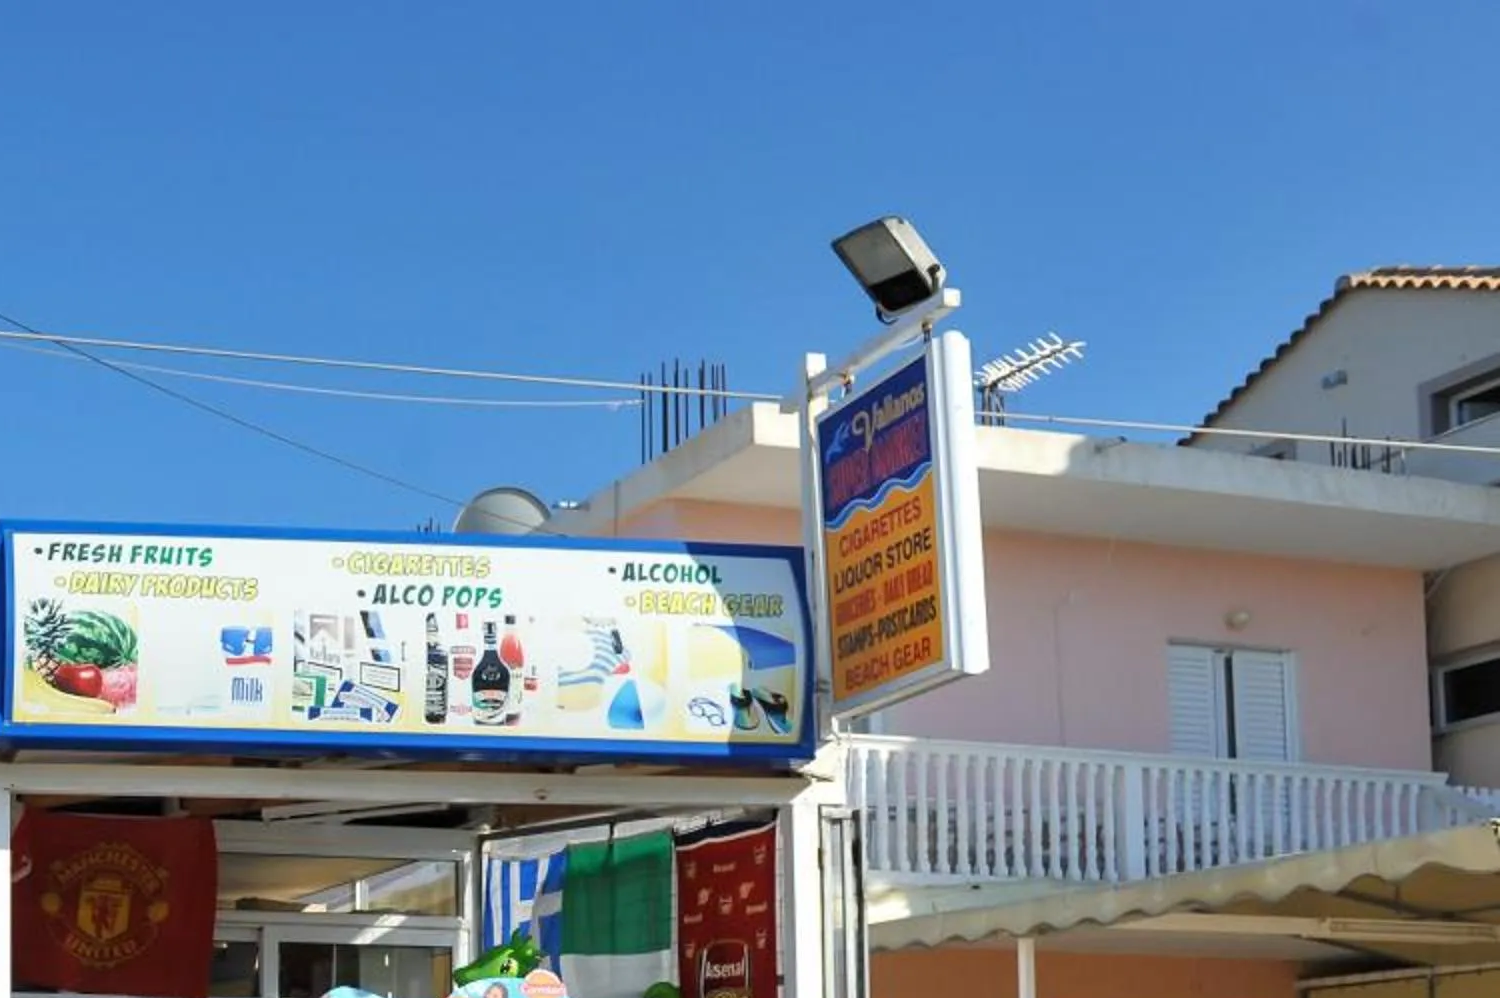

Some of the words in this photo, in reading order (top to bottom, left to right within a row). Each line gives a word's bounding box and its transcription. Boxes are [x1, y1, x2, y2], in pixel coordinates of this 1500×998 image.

[838, 496, 921, 557] CIGARETTES
[47, 542, 124, 563] FRESH
[129, 545, 213, 567] FRUITS
[346, 551, 491, 579] CIGARETTES
[834, 549, 884, 595] LIQUOR
[885, 528, 932, 571] STORE
[68, 570, 139, 597] DAIRY
[140, 573, 259, 602] PRODUCTS
[621, 562, 723, 585] ALCOHOL
[372, 584, 434, 607] ALCO
[441, 585, 503, 609] POPS
[639, 589, 716, 616] BEACH
[722, 593, 785, 618] GEAR
[844, 649, 890, 693] BEACH
[892, 635, 932, 674] GEAR
